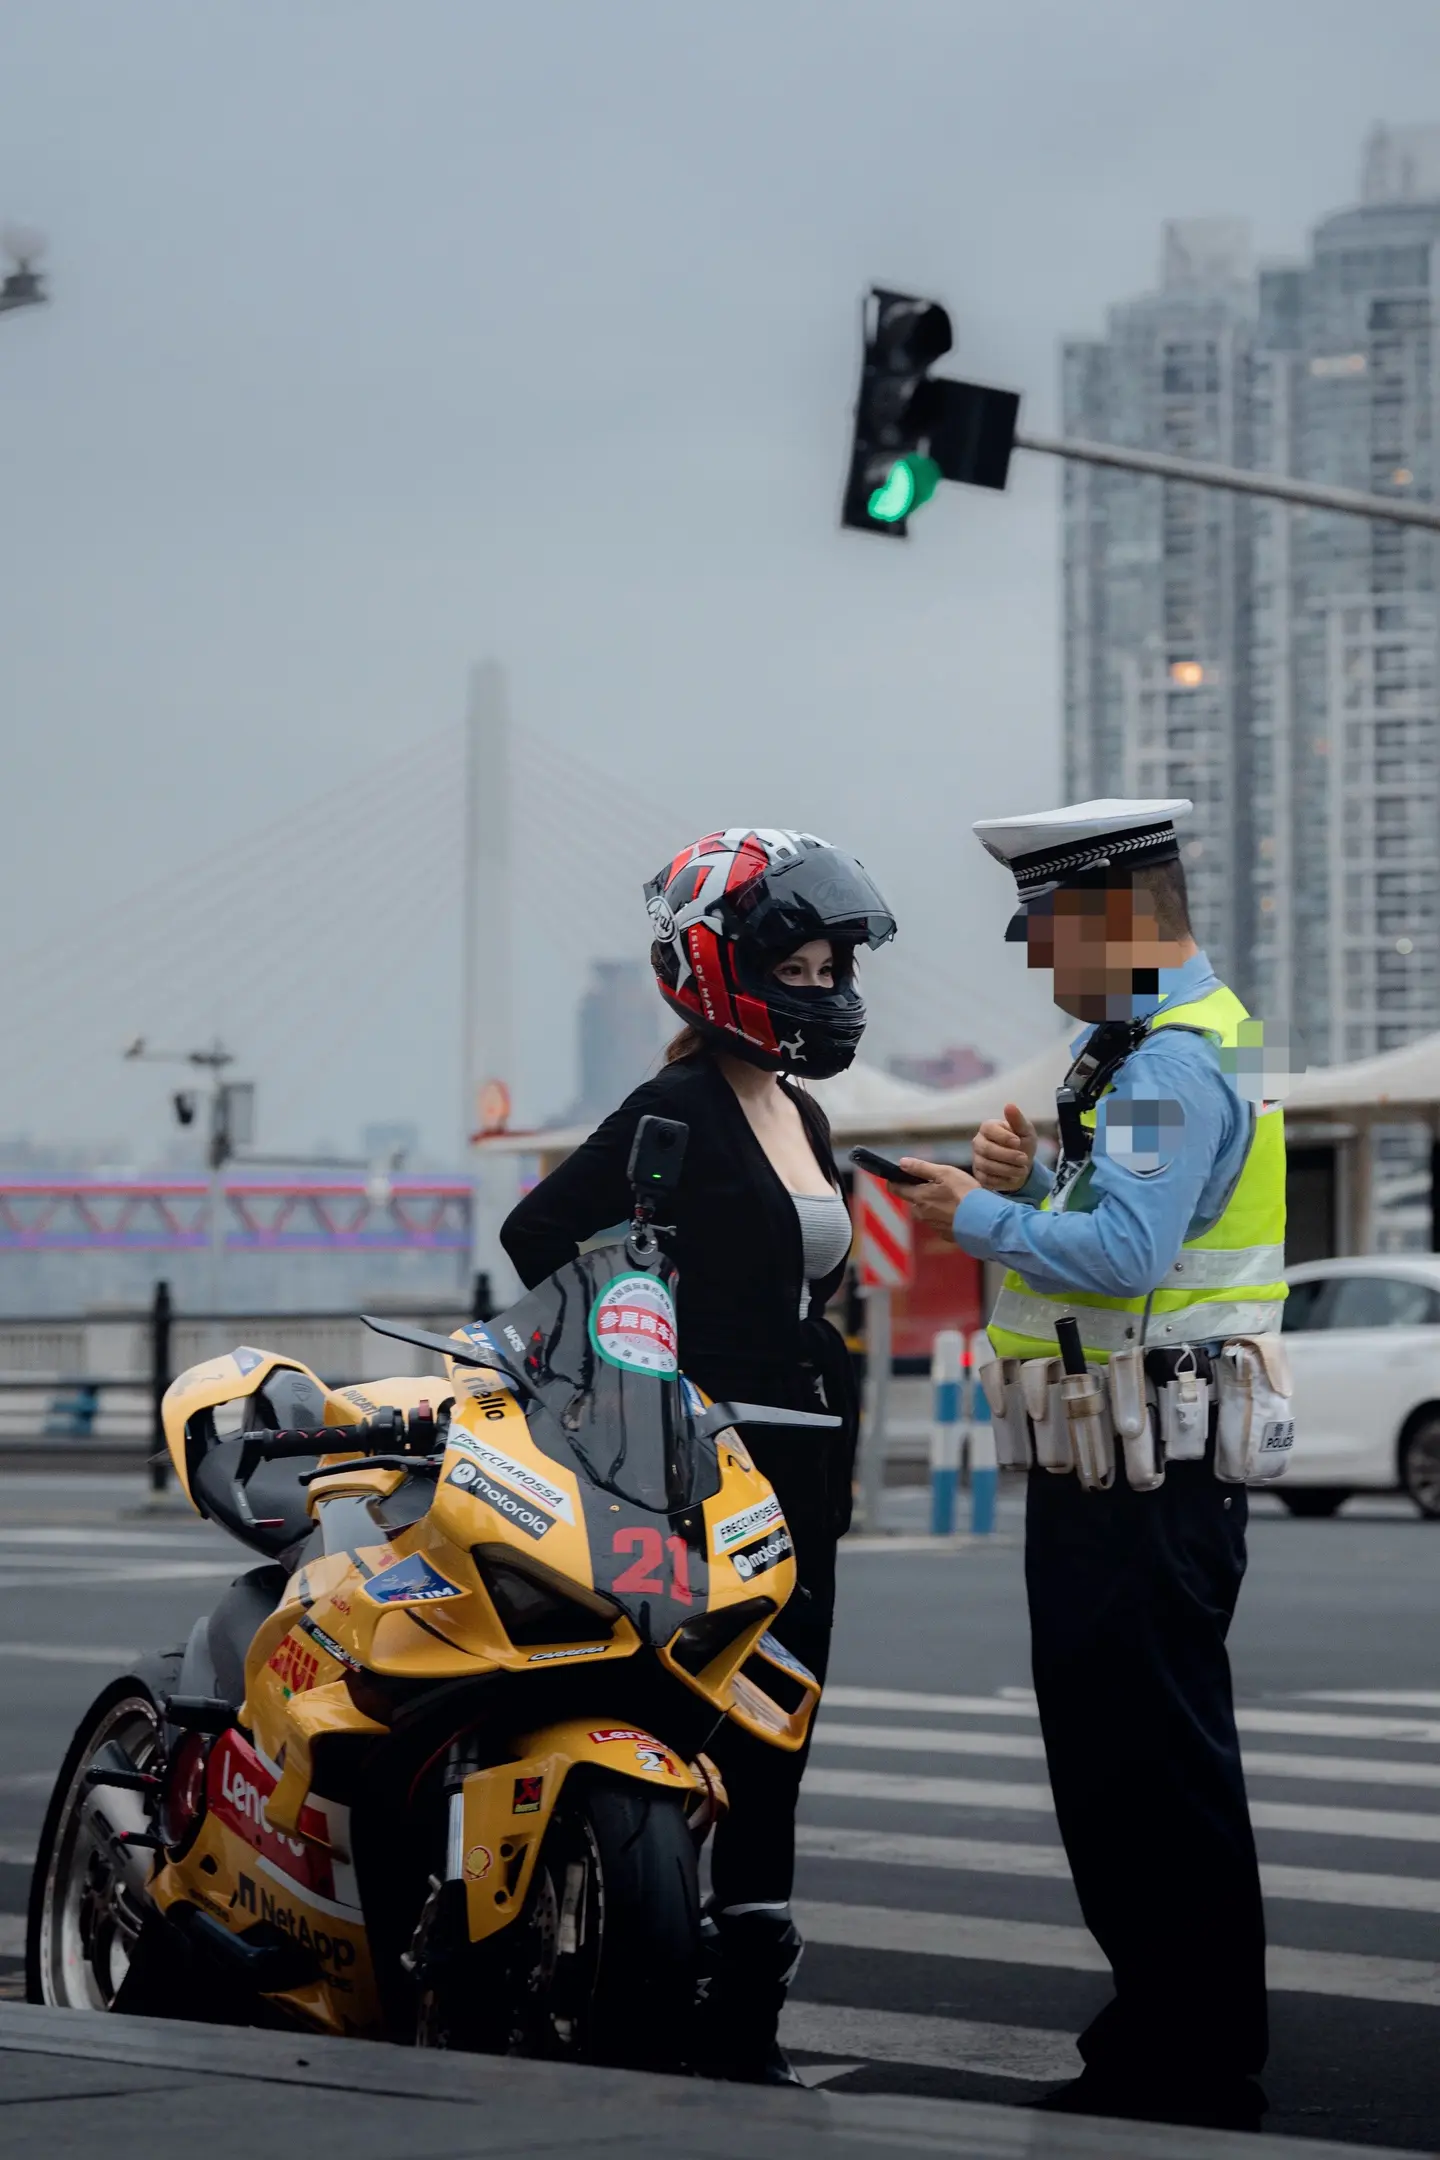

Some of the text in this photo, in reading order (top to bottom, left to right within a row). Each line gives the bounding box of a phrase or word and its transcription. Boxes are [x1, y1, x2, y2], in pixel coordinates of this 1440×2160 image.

[690, 929, 716, 1021] ISLE OF MAN
[342, 1389, 380, 1416] DUCATI
[462, 1377, 507, 1421] riello
[454, 1433, 565, 1505] FRECCIAROSSA
[471, 1477, 549, 1535] motorola
[720, 1502, 780, 1537] FRECCIAROSS
[612, 1527, 693, 1606] 21
[748, 1534, 793, 1567] motorol
[410, 1587, 455, 1600] TIM
[529, 1646, 606, 1661] CARRERA
[261, 1888, 355, 1967] NetApp
